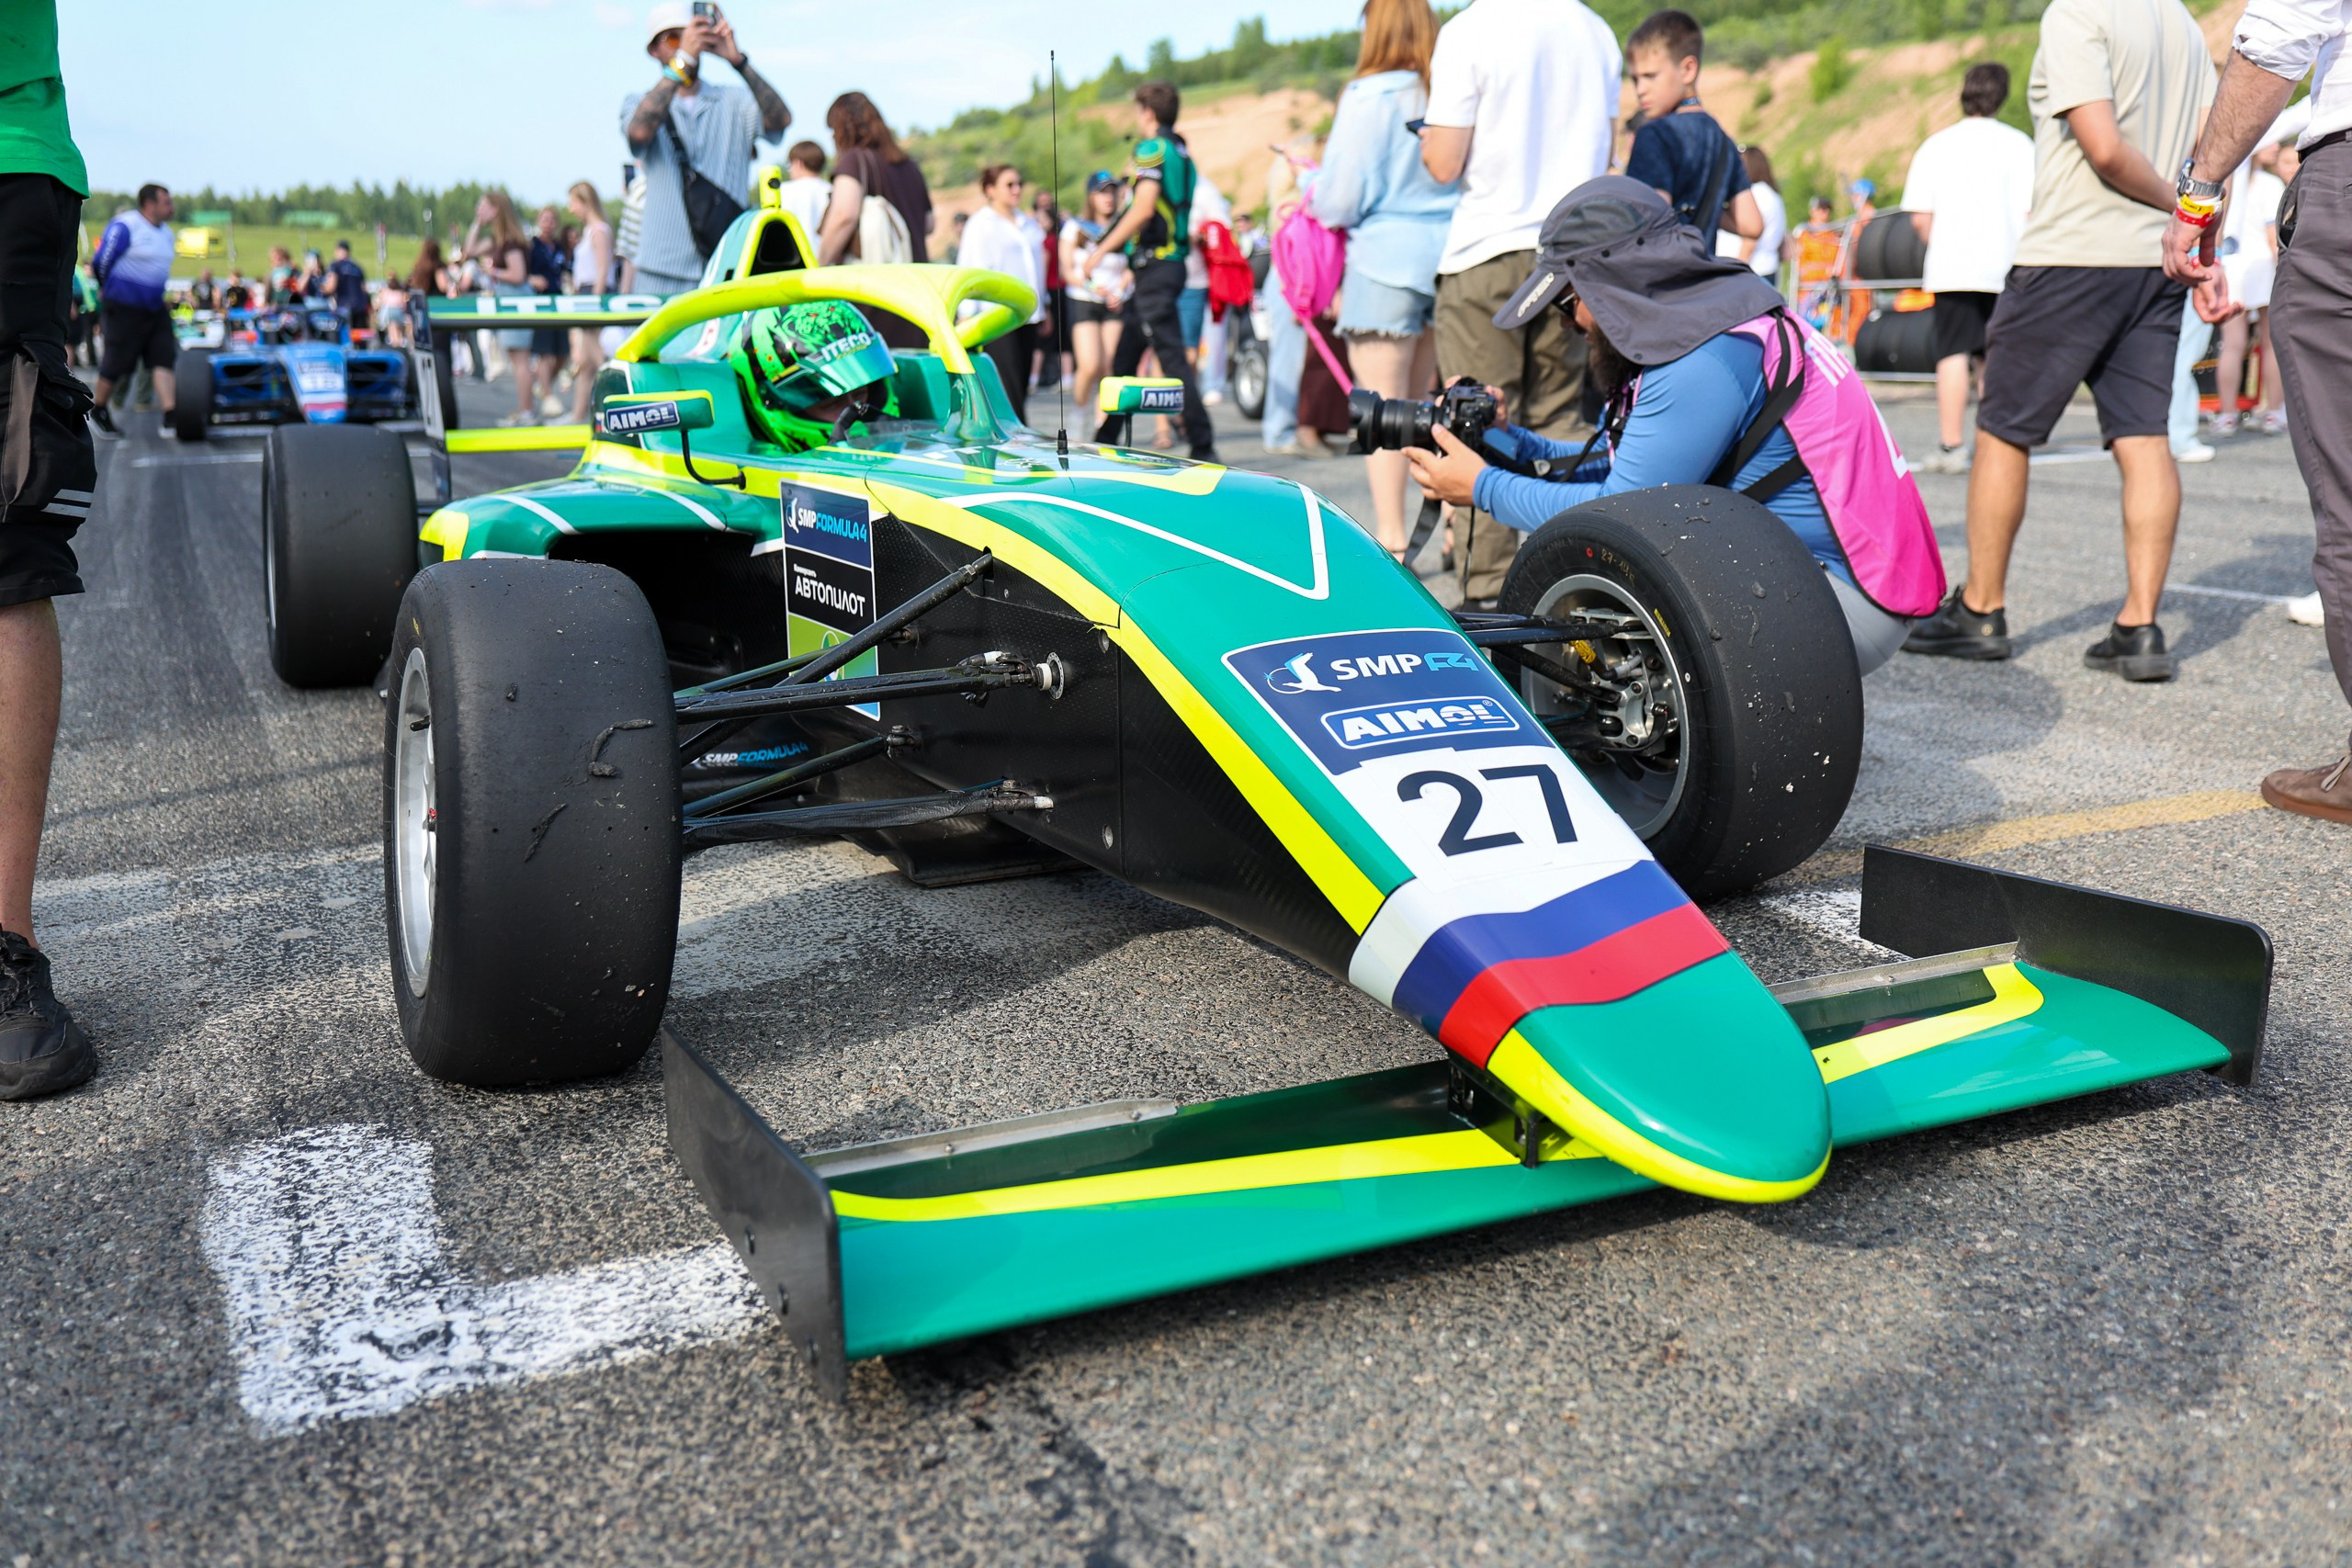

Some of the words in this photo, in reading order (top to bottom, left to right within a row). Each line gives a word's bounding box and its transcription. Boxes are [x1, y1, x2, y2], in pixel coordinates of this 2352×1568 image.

[820, 332, 872, 363] ITECO
[610, 406, 675, 431] AIMOL
[795, 575, 865, 617] АВТОПИЛОТ
[1396, 763, 1578, 857] 27
